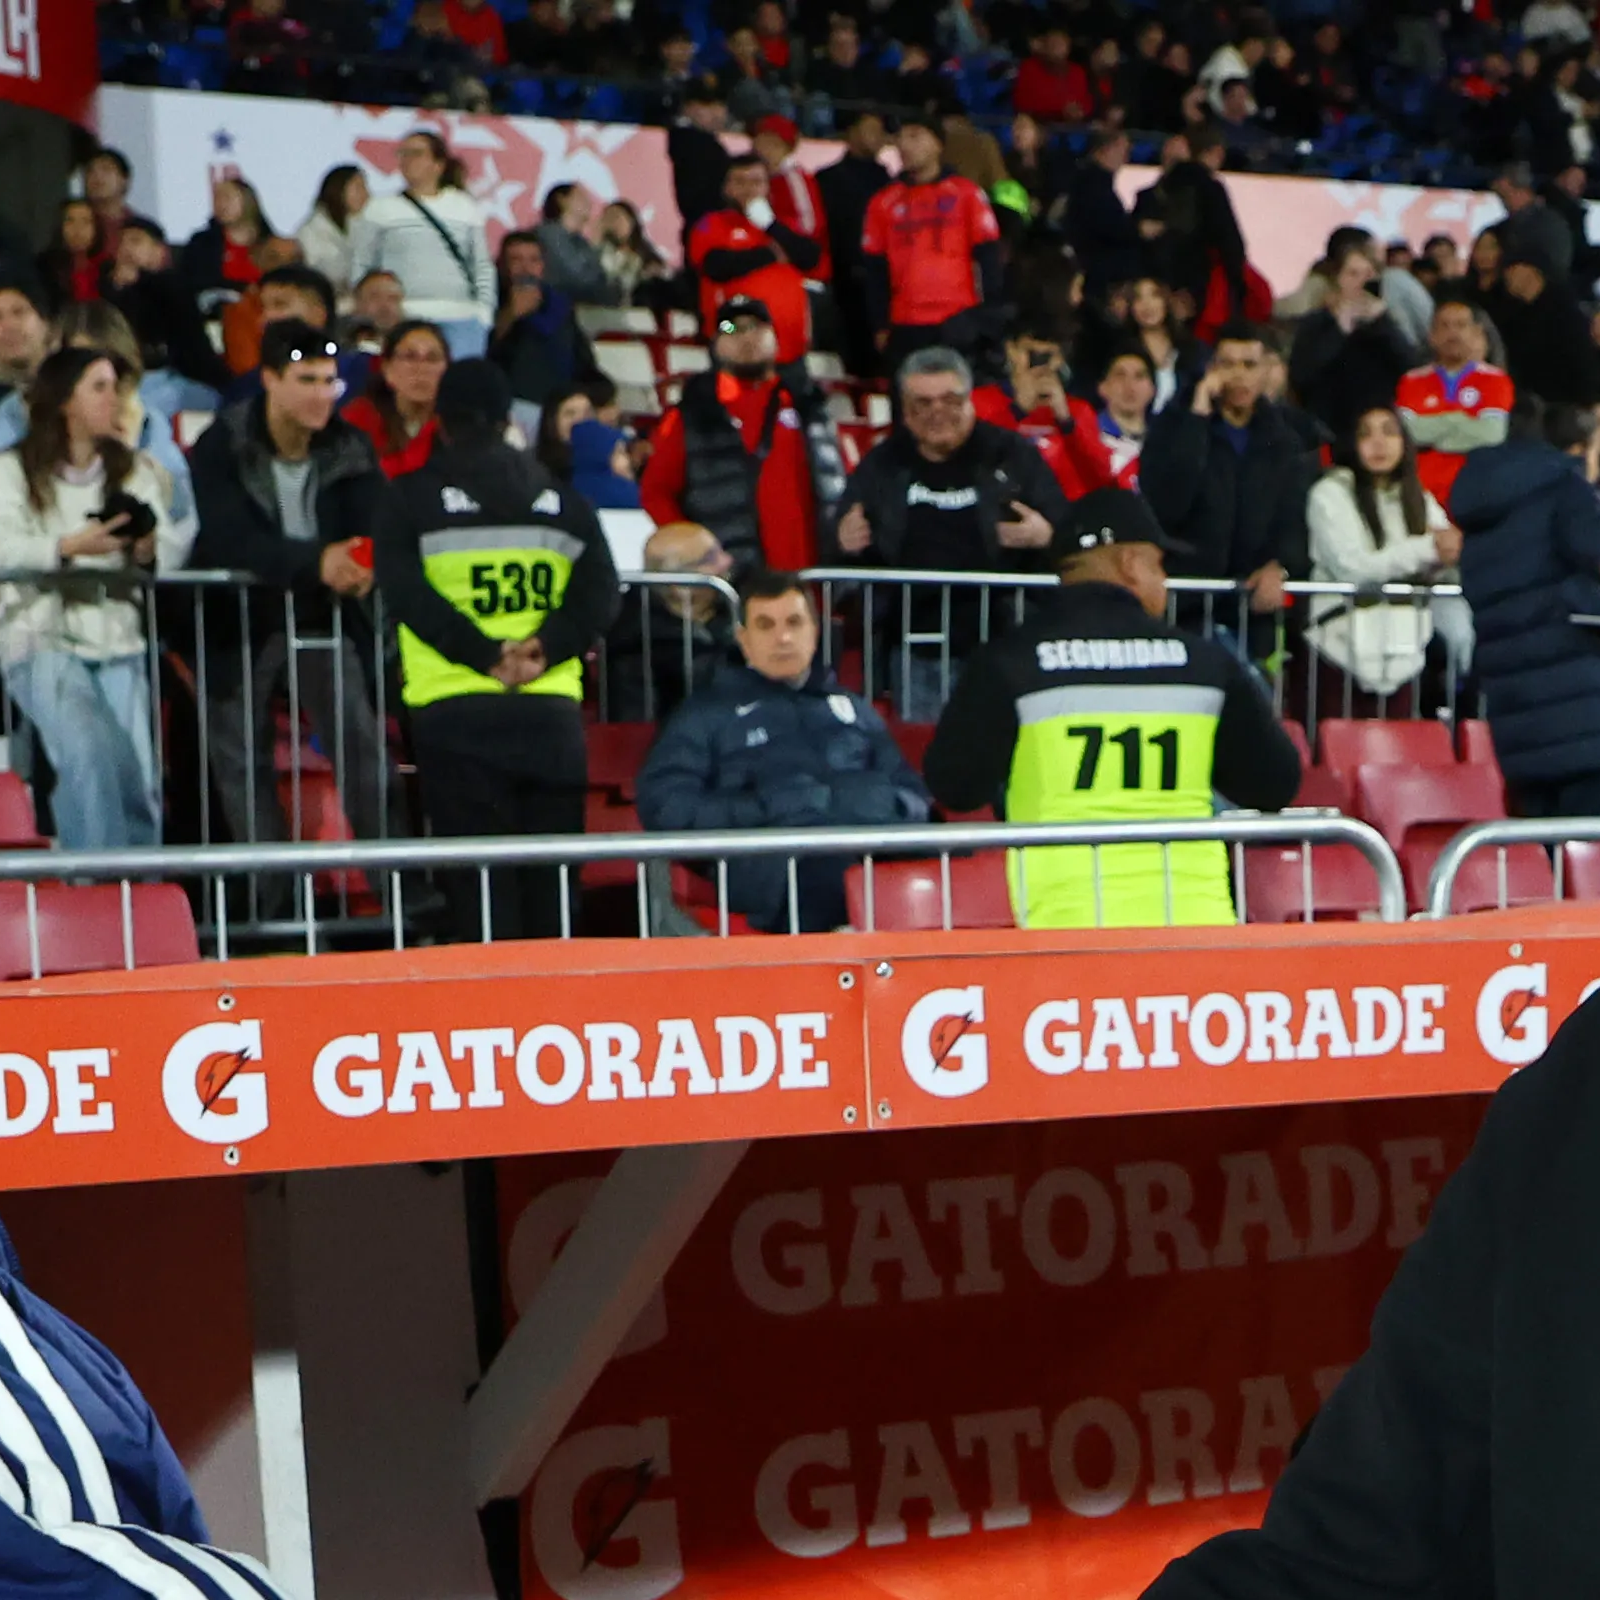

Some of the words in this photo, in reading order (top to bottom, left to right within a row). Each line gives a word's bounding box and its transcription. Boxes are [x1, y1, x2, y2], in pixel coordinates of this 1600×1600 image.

[471, 562, 554, 617] 539
[1066, 725, 1178, 790] 711
[162, 1018, 269, 1144] G
[312, 1011, 830, 1118] GATORADE
[901, 985, 989, 1098] G
[1022, 983, 1445, 1075] GATORADE
[1475, 962, 1548, 1065] G
[730, 1138, 1453, 1316] GATORADE
[754, 1368, 1349, 1560] GATORA
